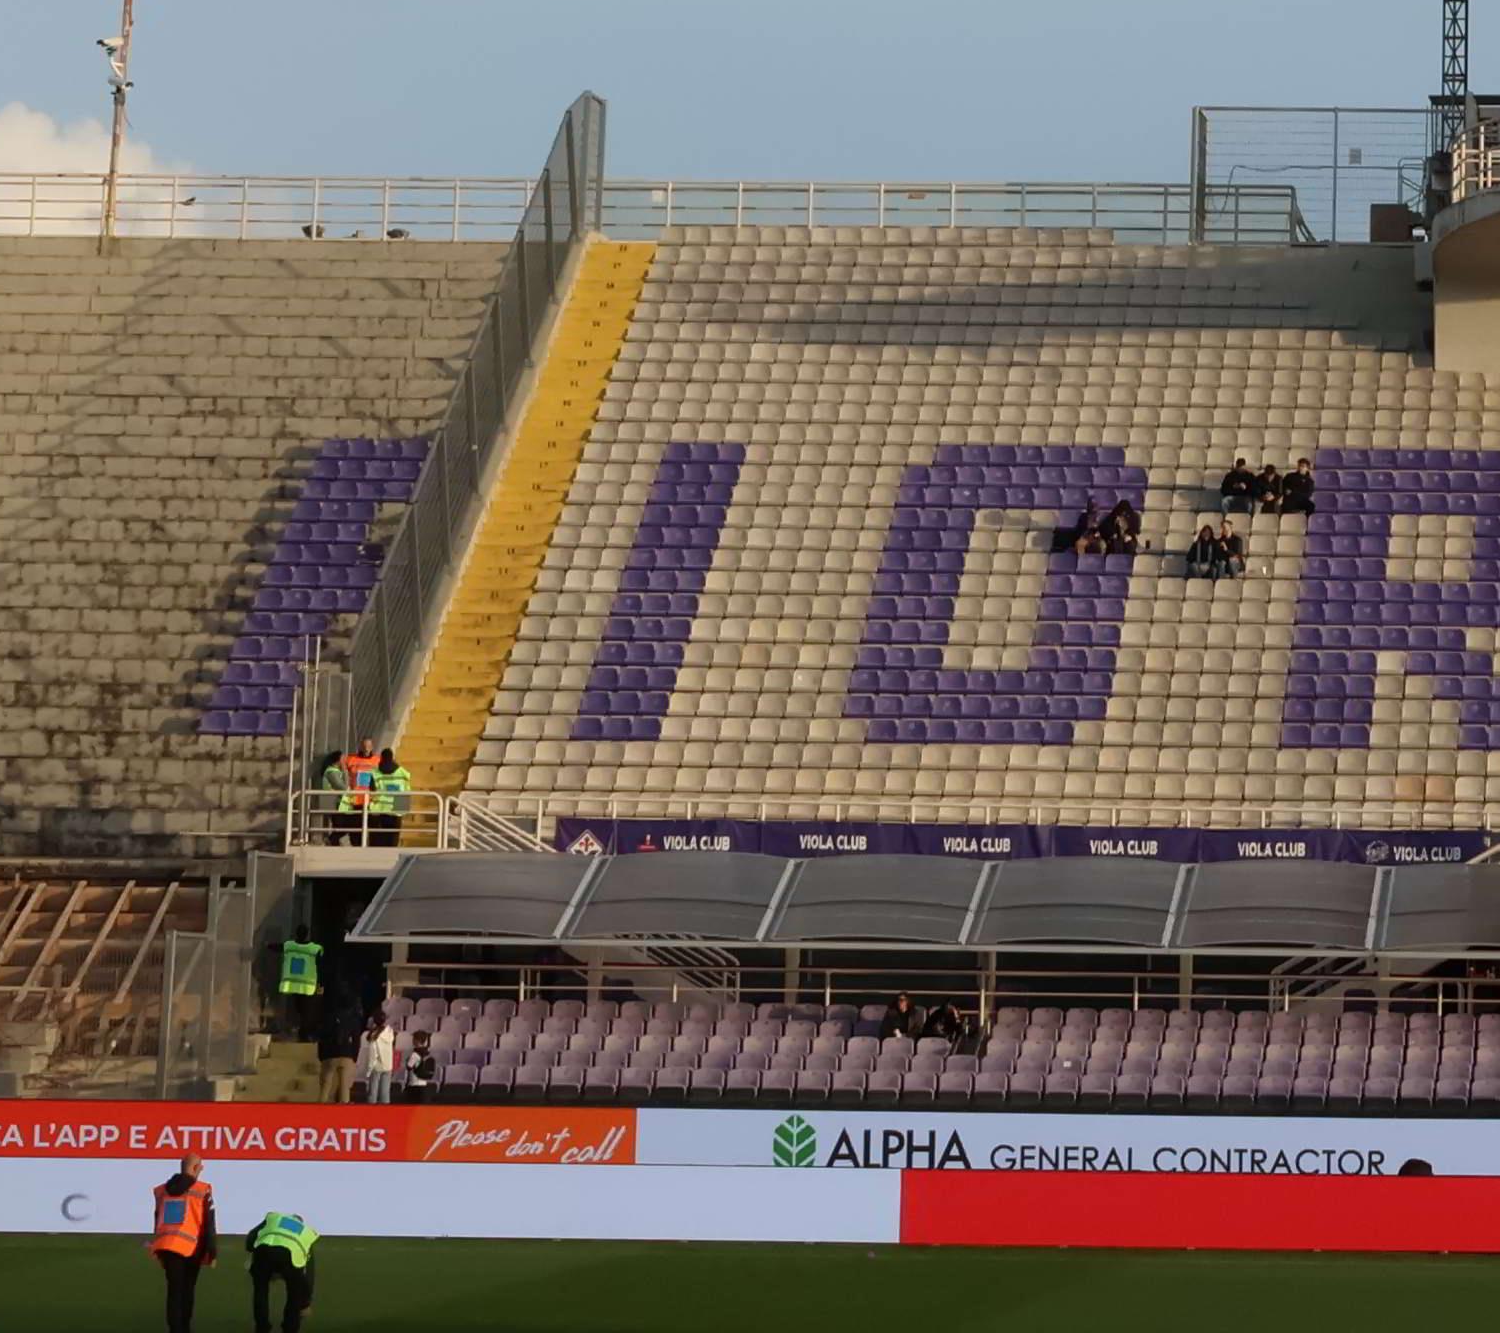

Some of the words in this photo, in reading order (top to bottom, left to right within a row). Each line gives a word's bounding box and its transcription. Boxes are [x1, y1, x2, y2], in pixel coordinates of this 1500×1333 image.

[663, 835, 697, 851] VIOLA
[700, 835, 730, 851] CLUB
[800, 834, 833, 849] VIOLA
[837, 834, 867, 849] CLUB
[943, 836, 977, 853] VIOLA
[981, 836, 1010, 853] CLUB
[1090, 840, 1123, 855] VIOLA
[1127, 840, 1157, 855] CLUB
[1238, 841, 1271, 857] VIOLA
[1275, 841, 1305, 857] CLUB
[1393, 846, 1428, 861] VIOLA
[1431, 846, 1461, 861] CLUB
[34, 1124, 119, 1150] L'APP
[129, 1125, 147, 1150] E
[155, 1125, 266, 1151] ATTIVA
[275, 1127, 386, 1152] GRATIS
[423, 1119, 511, 1160] Please
[505, 1127, 570, 1158] don't
[561, 1125, 626, 1164] call
[826, 1129, 971, 1169] ALPHA
[990, 1144, 1135, 1173] GENERAL
[1152, 1146, 1385, 1176] CONTRACTOR
